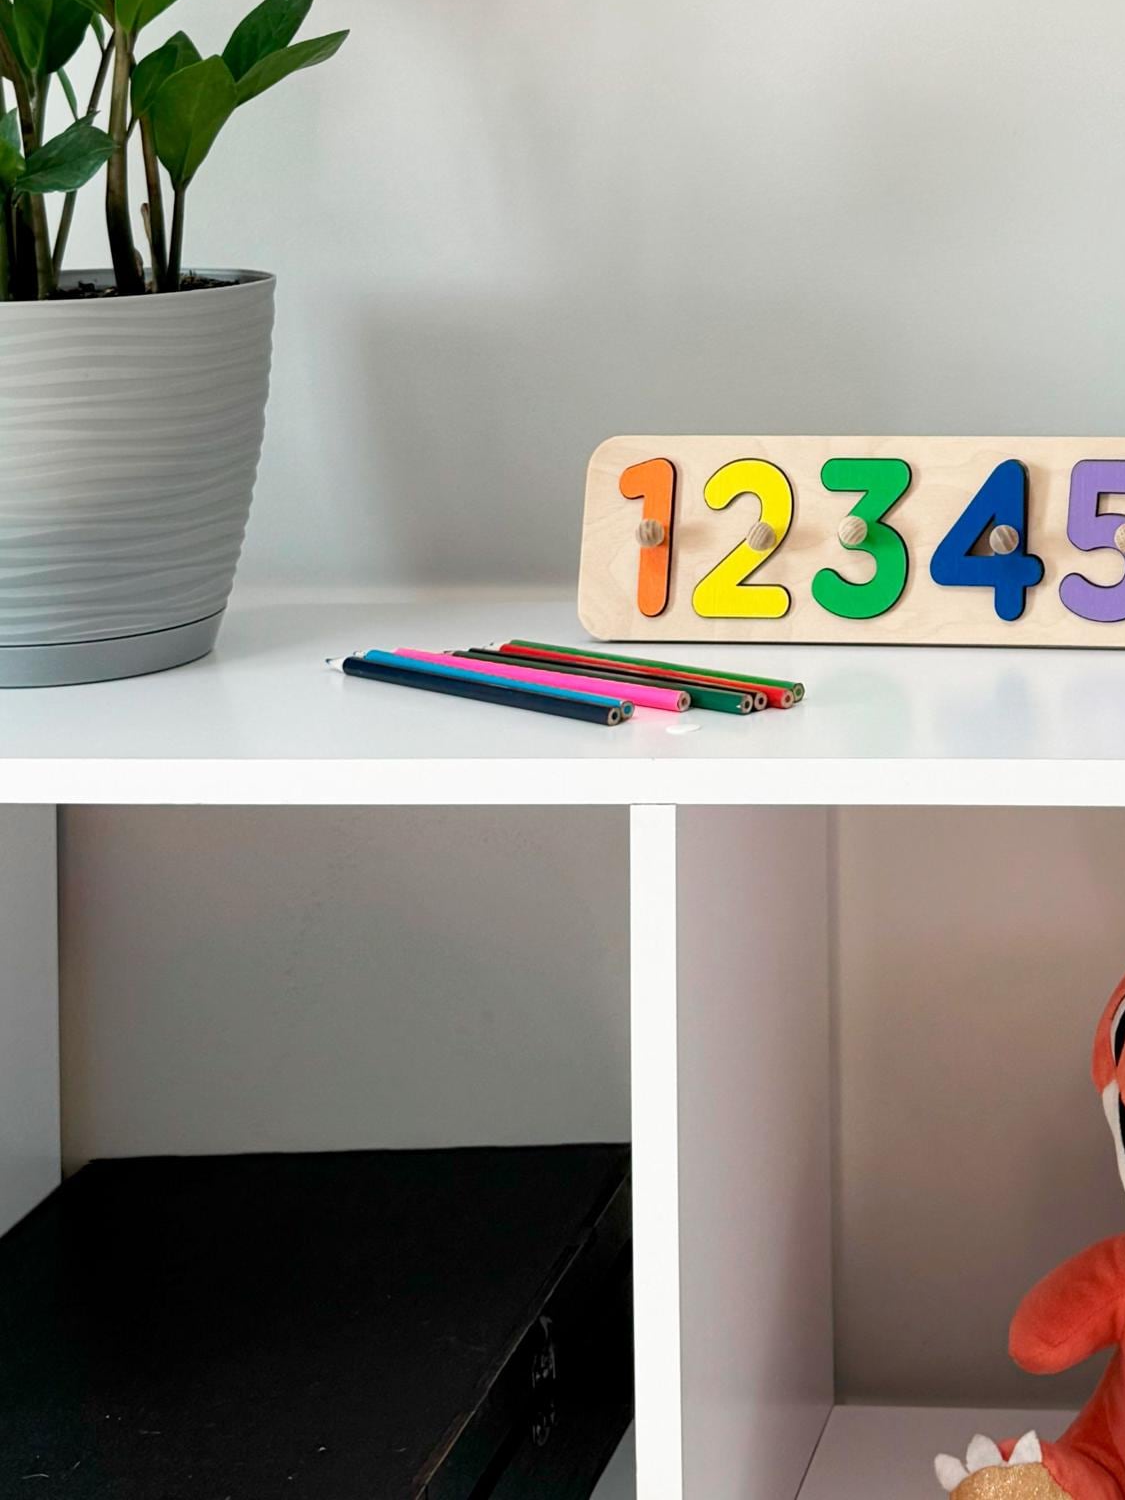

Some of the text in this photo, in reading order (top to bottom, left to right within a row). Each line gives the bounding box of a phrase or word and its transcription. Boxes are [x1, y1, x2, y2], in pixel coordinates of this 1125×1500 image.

[619, 458, 675, 616] 1
[692, 458, 794, 619] 2
[811, 458, 912, 619] 3
[930, 459, 1045, 621] 4
